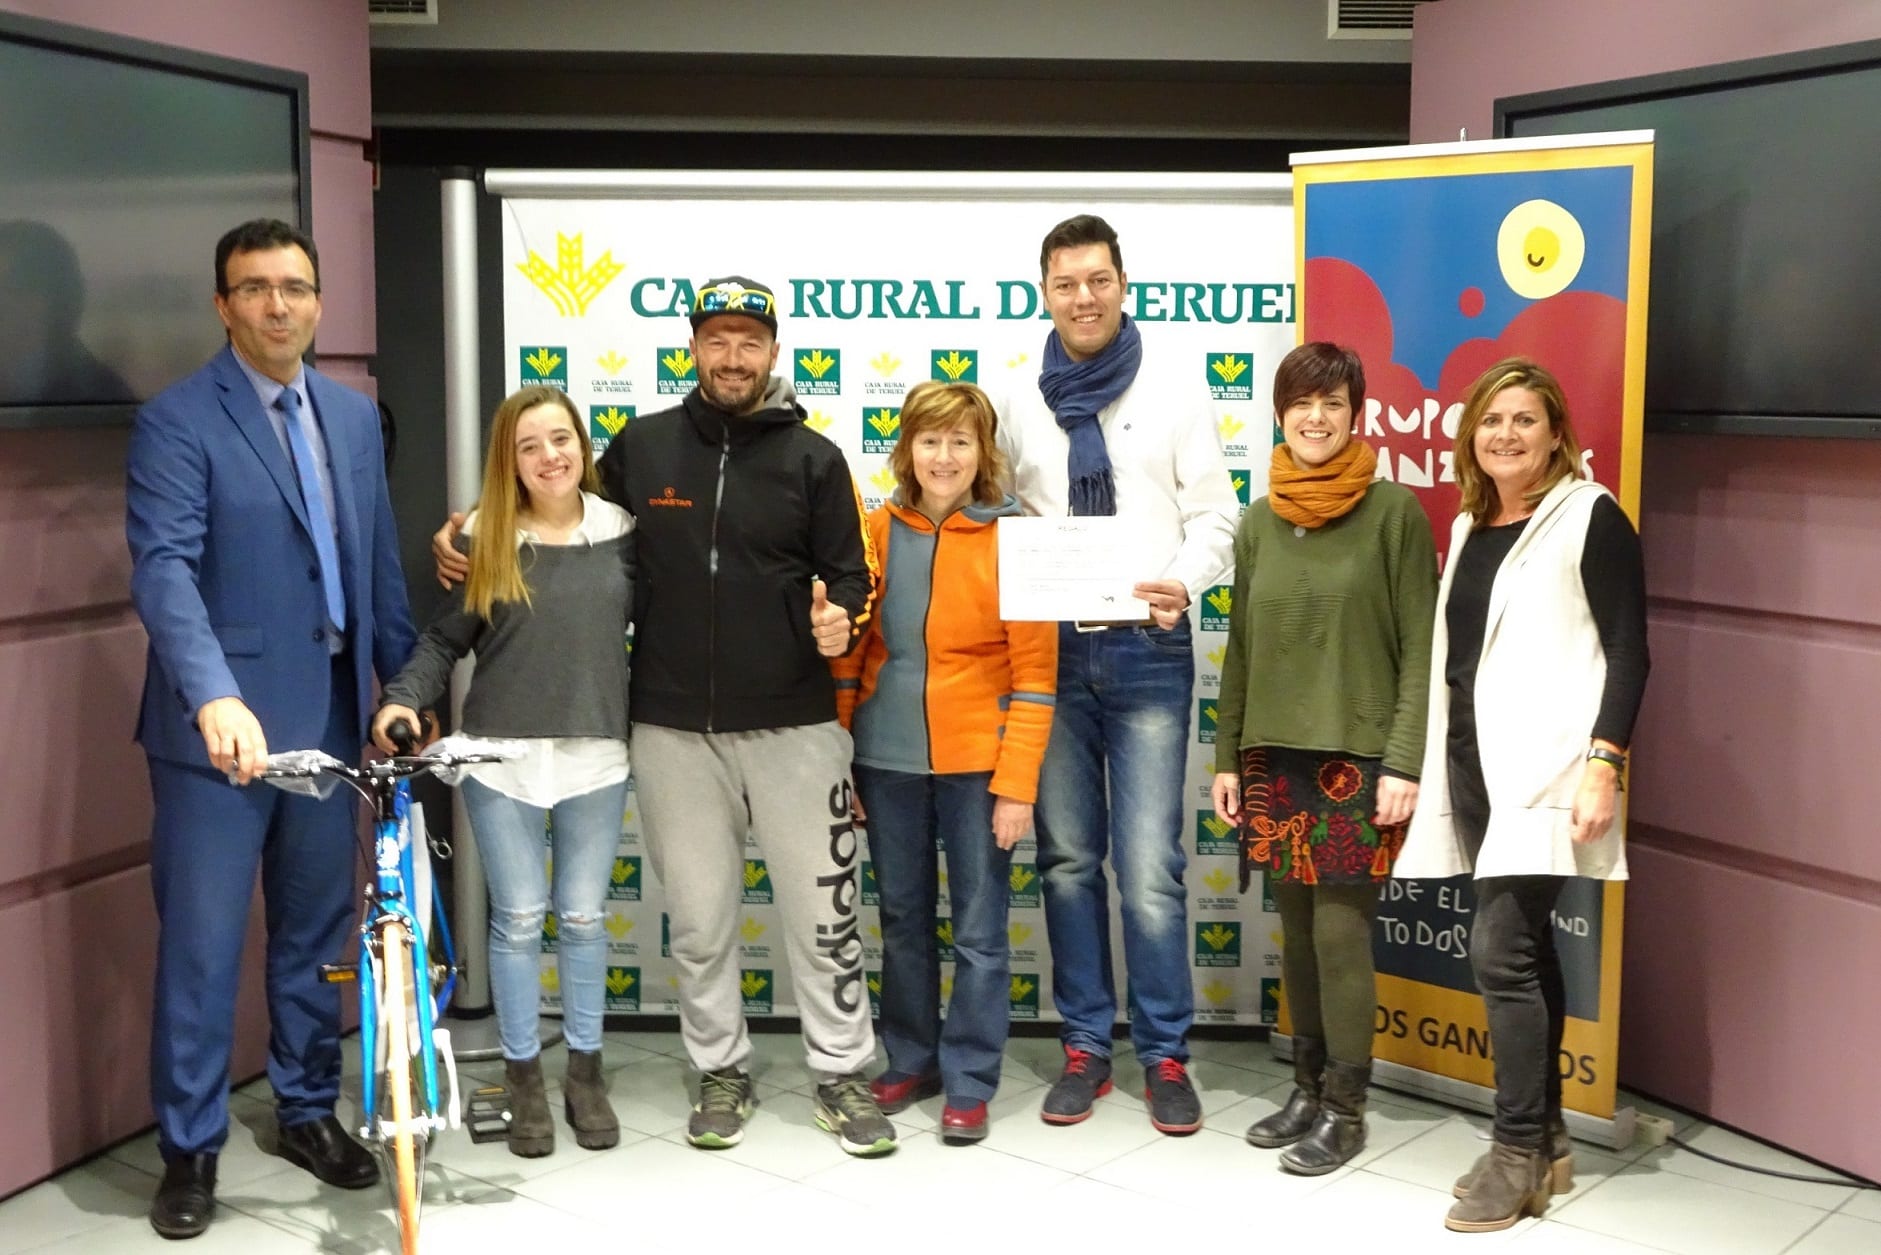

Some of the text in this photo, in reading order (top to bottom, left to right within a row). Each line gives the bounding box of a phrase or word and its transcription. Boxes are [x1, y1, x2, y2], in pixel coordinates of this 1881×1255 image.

[789, 278, 981, 320] RURAL
[1350, 398, 1466, 440] RUPO
[816, 777, 863, 1014] adidas
[1437, 885, 1471, 913] EL
[1376, 915, 1468, 958] TODOS
